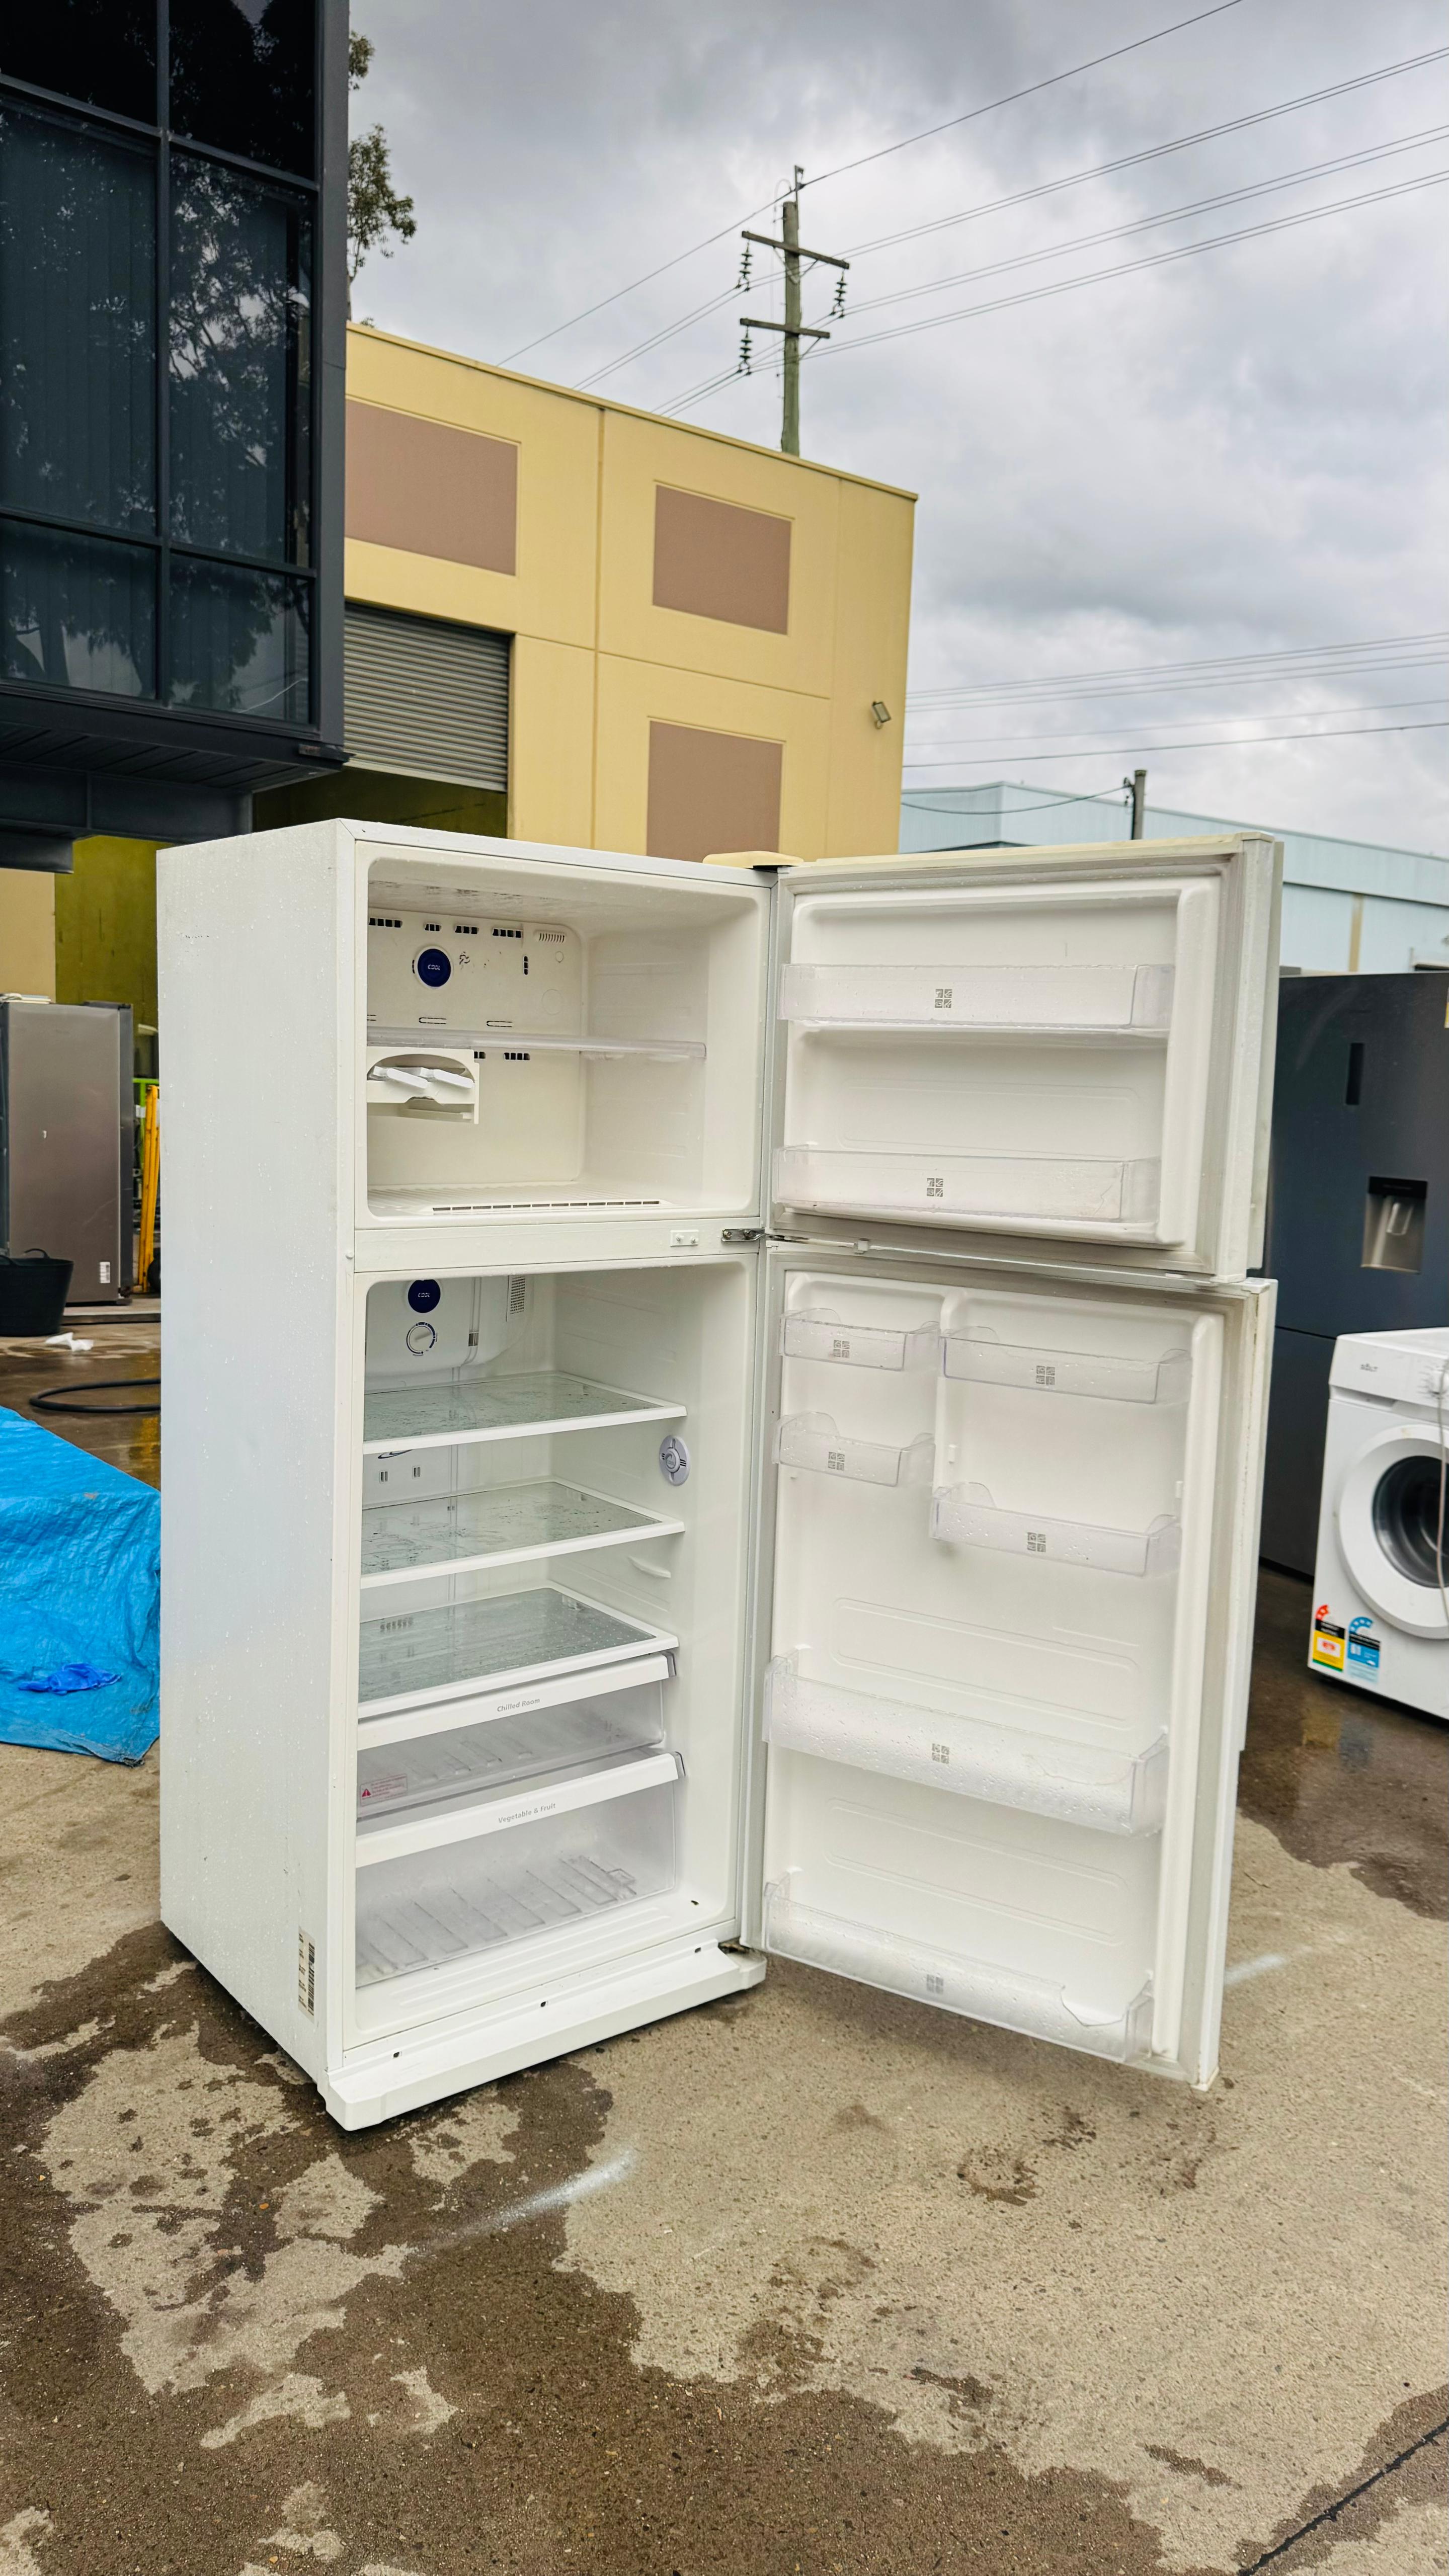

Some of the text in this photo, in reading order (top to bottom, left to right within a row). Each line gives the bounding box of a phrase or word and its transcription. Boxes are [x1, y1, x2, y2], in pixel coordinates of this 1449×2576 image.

[497, 1699, 540, 1712] Chilled Room
[498, 1810, 532, 1823] Vegetable
[540, 1803, 556, 1812] Fruit
